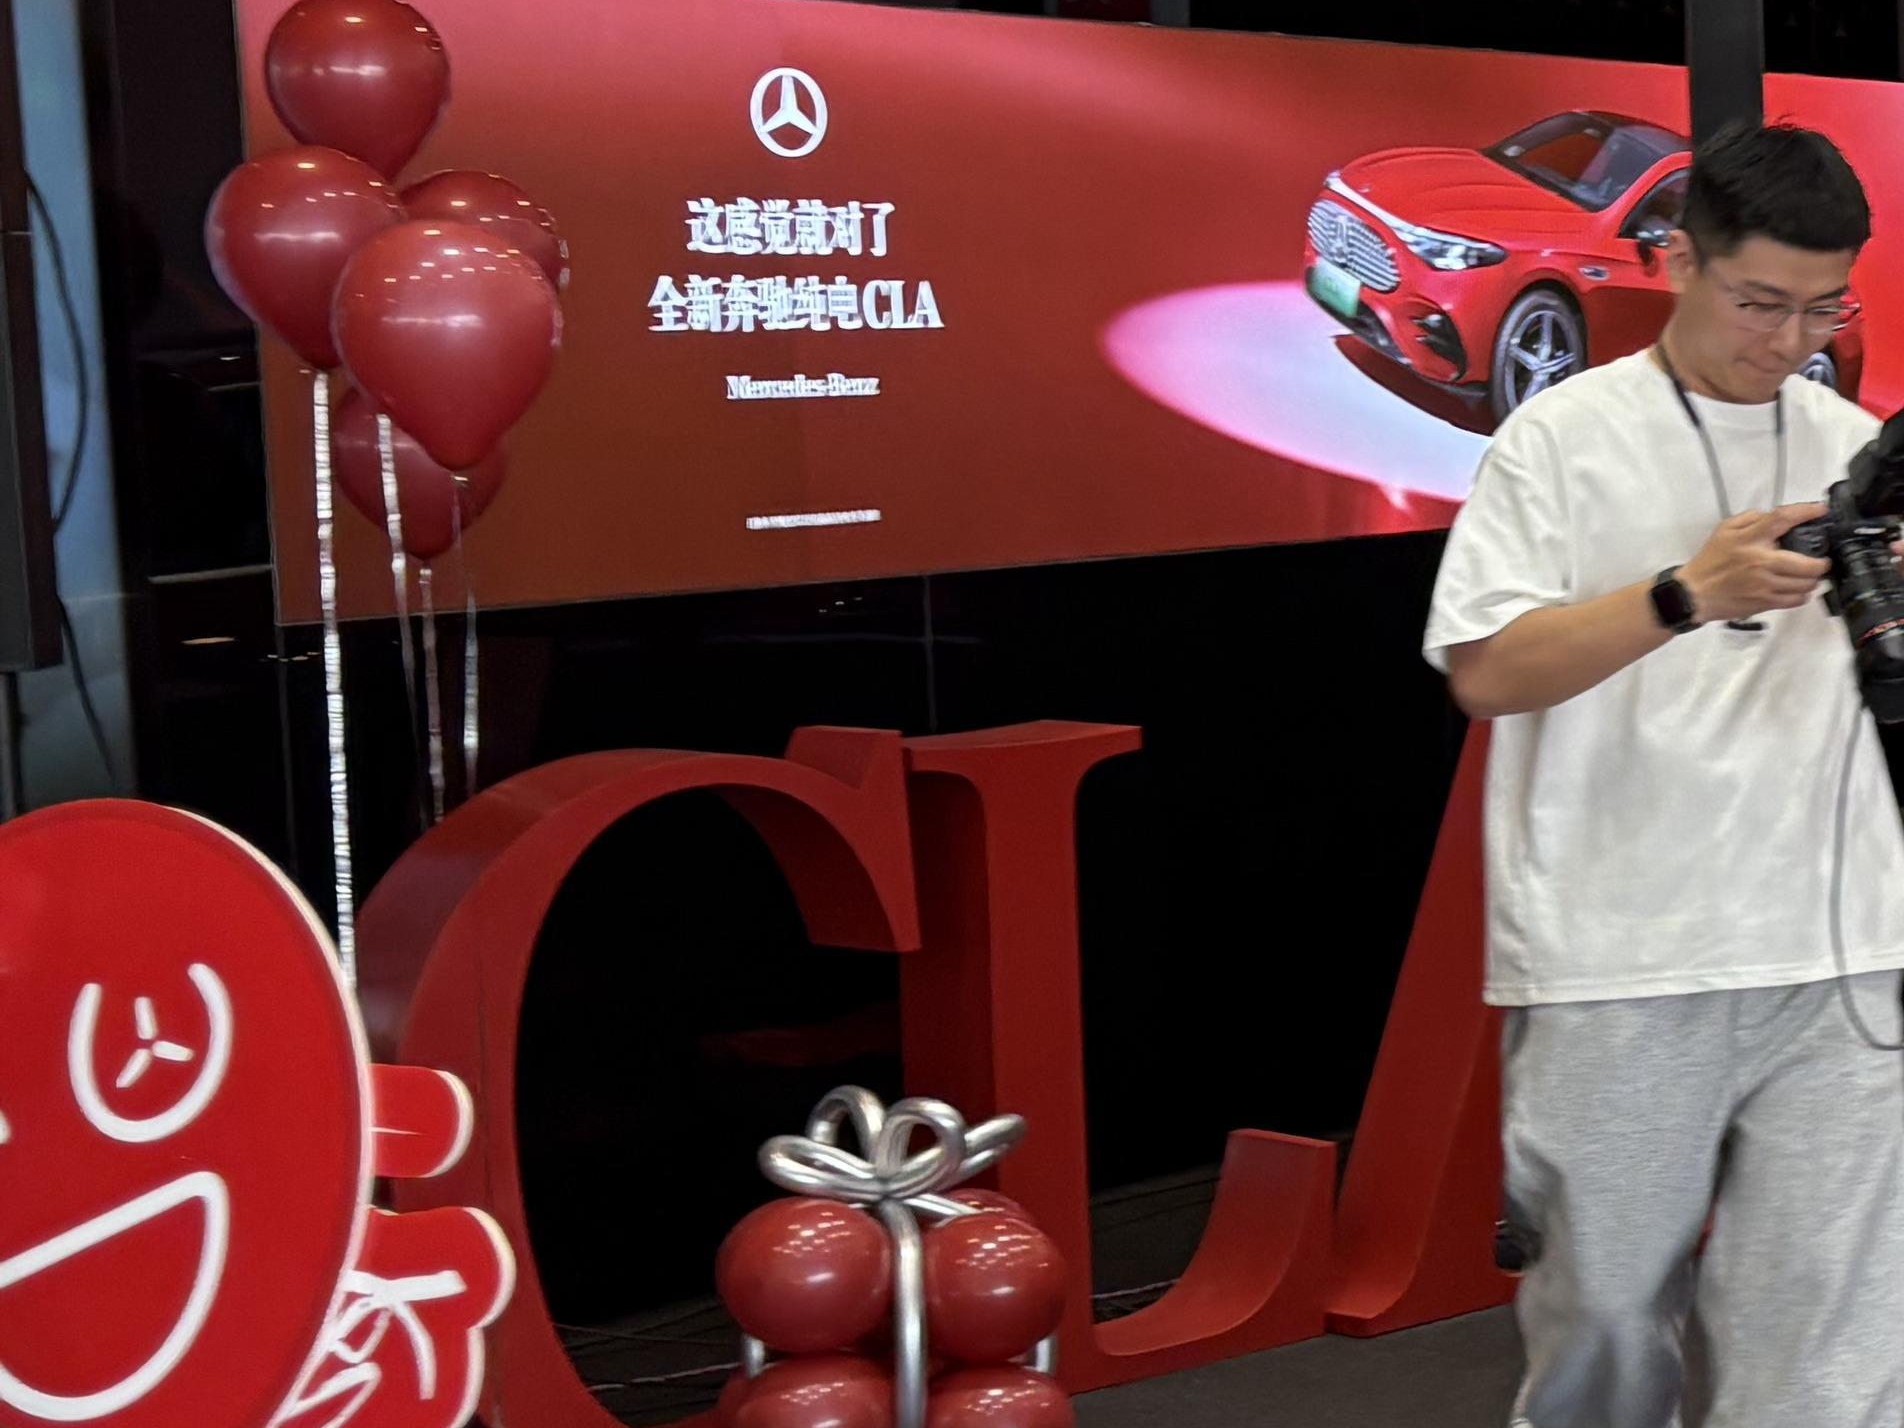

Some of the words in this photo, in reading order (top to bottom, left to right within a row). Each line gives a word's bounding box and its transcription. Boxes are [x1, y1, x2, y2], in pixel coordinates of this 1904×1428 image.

[685, 197, 896, 256] 这感觉就对了
[648, 274, 945, 332] 全新奔驰纯电CLA
